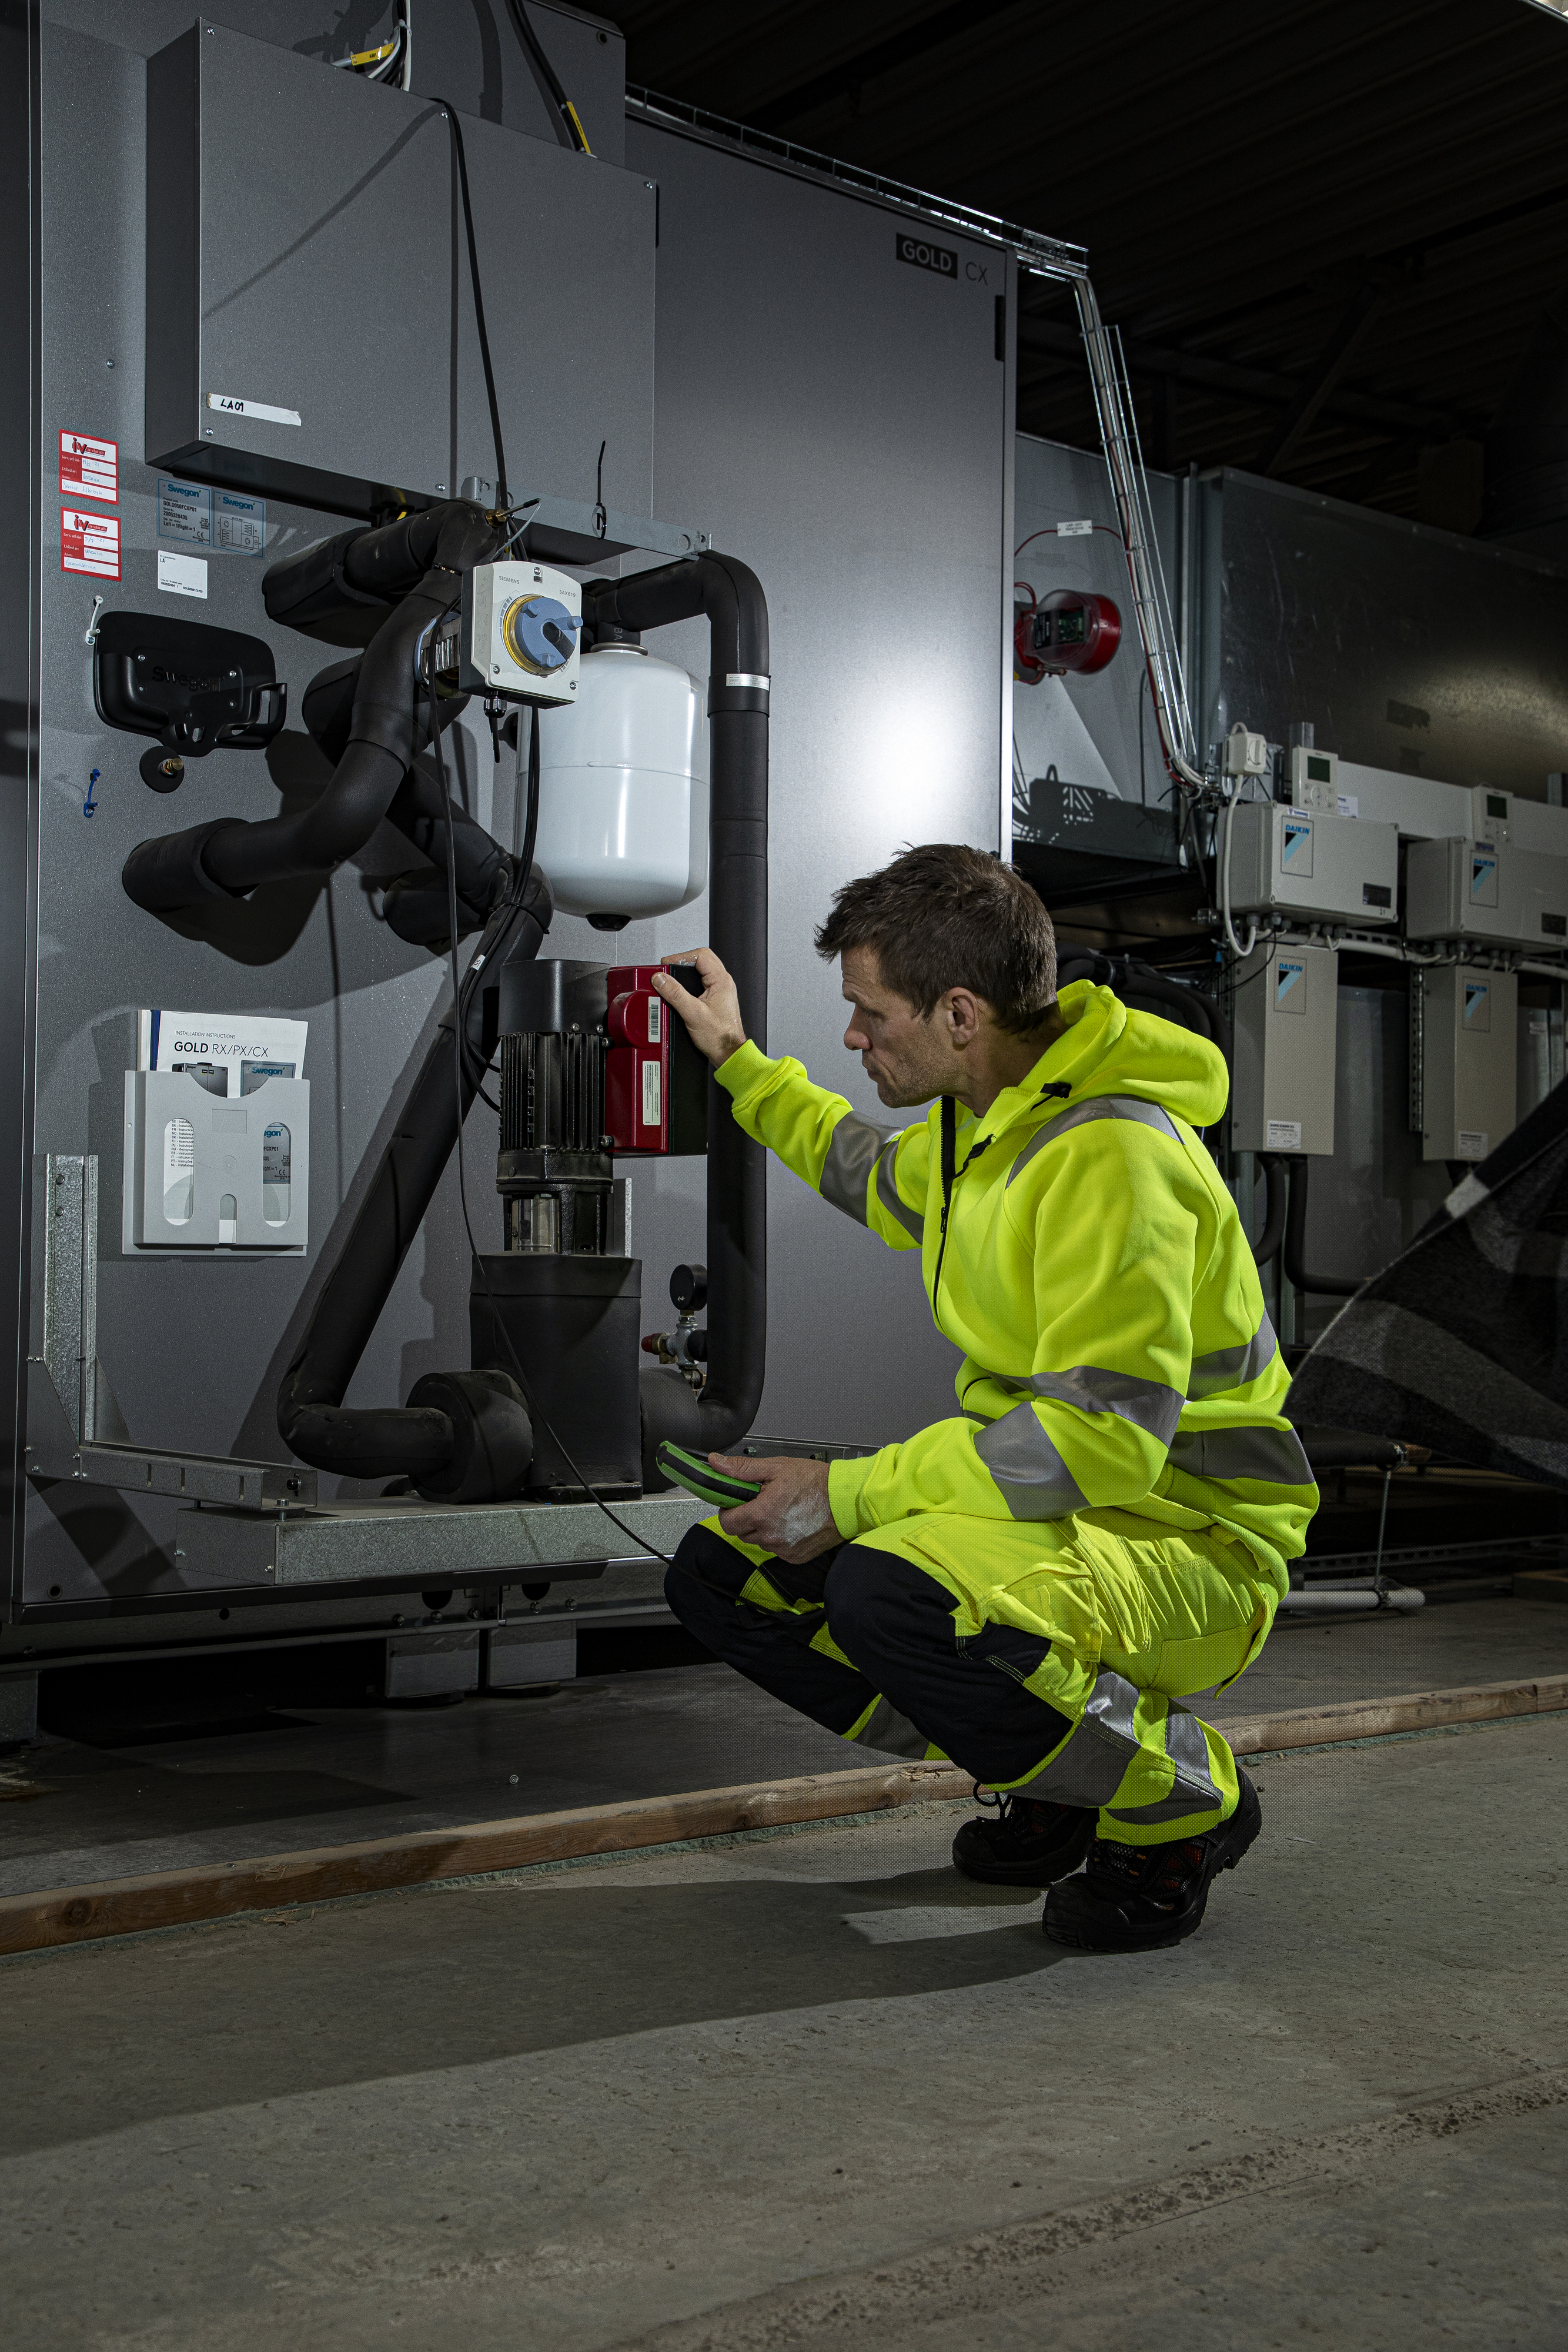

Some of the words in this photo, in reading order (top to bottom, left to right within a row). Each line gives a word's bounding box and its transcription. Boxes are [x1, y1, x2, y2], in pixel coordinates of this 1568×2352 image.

[902, 240, 952, 272] GOLD
[965, 261, 988, 285] CX
[220, 398, 244, 412] LA01
[82, 473, 100, 482] Veronica
[168, 483, 199, 497] Swegon
[163, 500, 197, 512] GOLD050FCXP01
[222, 496, 253, 510] Swegon
[163, 510, 188, 520] 2005328435
[499, 576, 520, 584] SIEMENS
[152, 666, 221, 692] Swegon
[1285, 824, 1310, 834] DAIKIN
[1279, 963, 1303, 971] DAIKIN
[174, 1041, 209, 1053] GOLD
[212, 1044, 269, 1058] RX/PX/CX
[252, 1065, 283, 1076] Swegon
